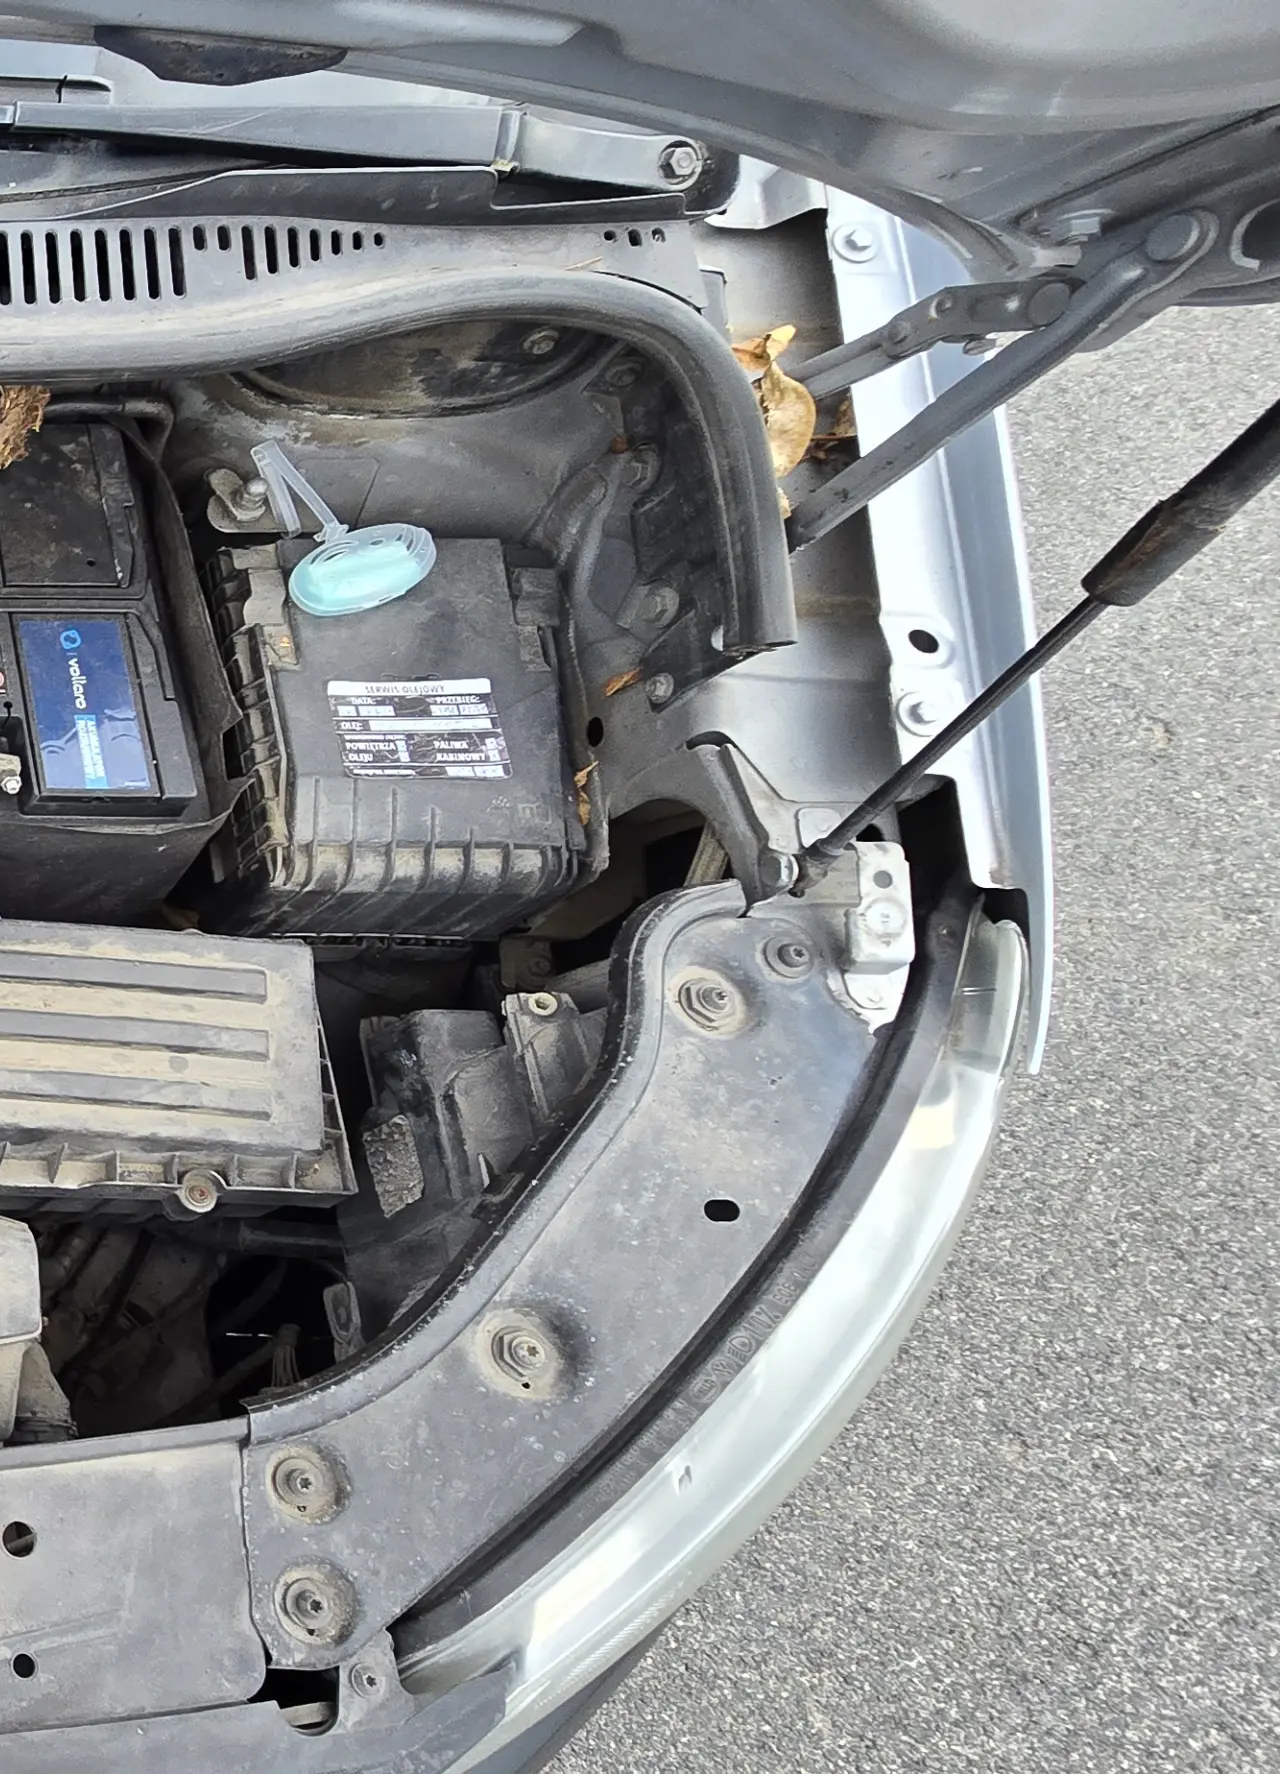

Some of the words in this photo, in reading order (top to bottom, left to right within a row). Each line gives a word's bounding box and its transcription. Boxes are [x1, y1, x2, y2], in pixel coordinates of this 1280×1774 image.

[67, 658, 88, 710] voltaro
[365, 685, 400, 694] SERWIS
[402, 685, 445, 695] OLEJOWY
